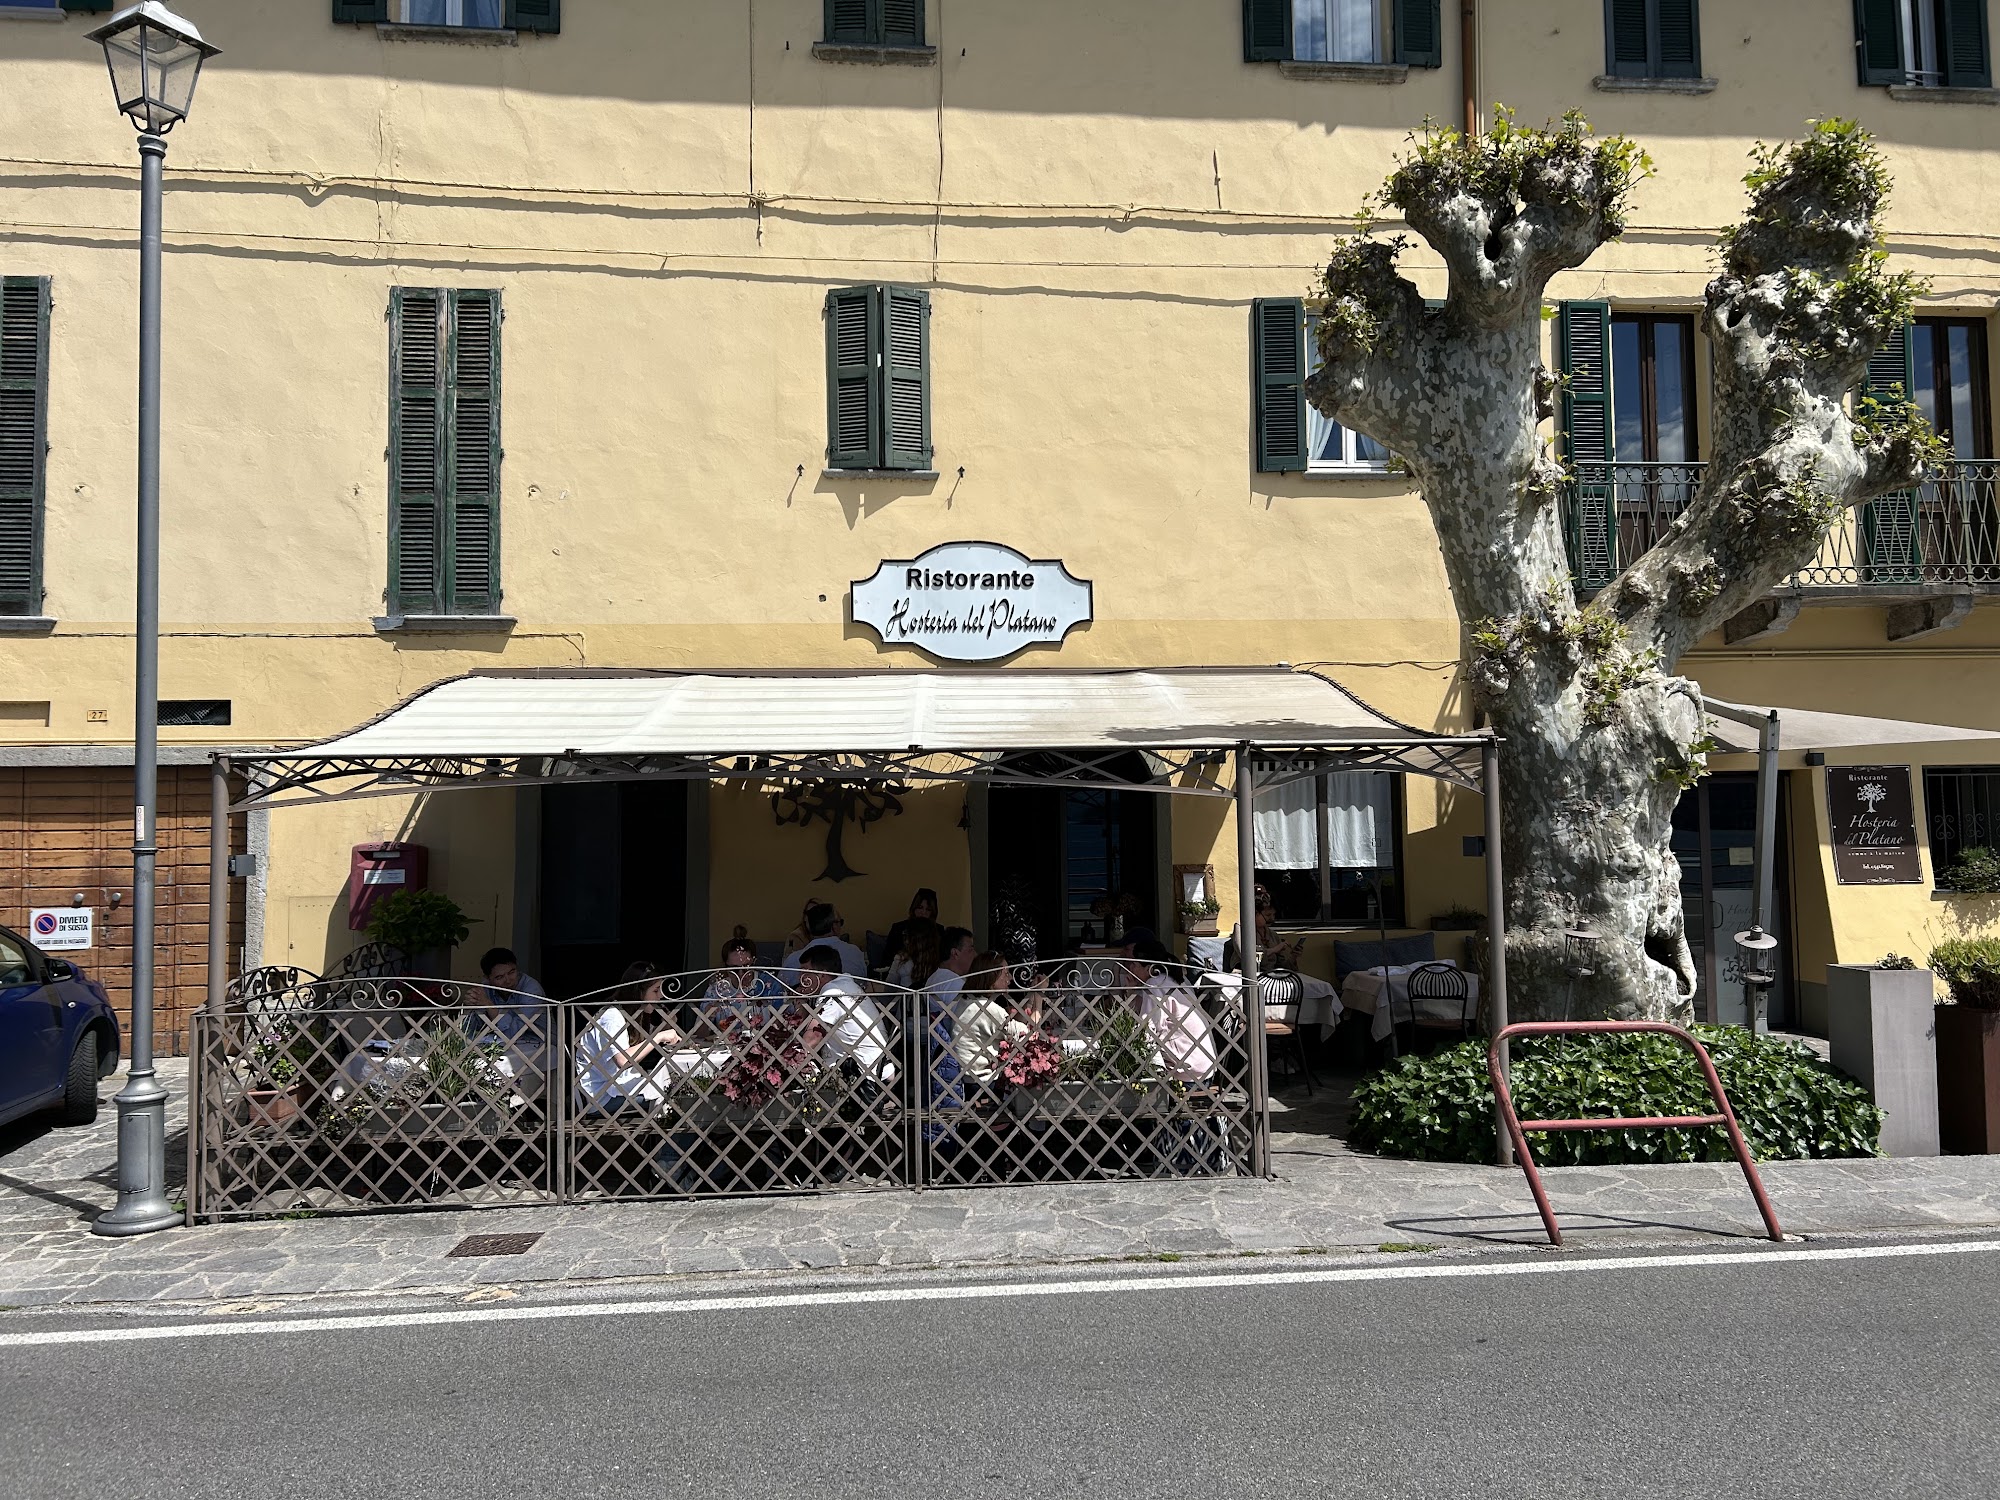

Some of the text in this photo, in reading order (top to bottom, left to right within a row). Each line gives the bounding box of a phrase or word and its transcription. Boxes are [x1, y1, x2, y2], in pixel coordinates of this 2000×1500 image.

[906, 568, 1035, 589] Ristorante
[886, 597, 1057, 640] Hosteria del Platano
[91, 711, 104, 720] 27
[1848, 774, 1888, 782] Ristorante
[1849, 813, 1899, 828] Hosteria
[1844, 827, 1904, 846] del Platano
[59, 916, 88, 924] DIVIETO
